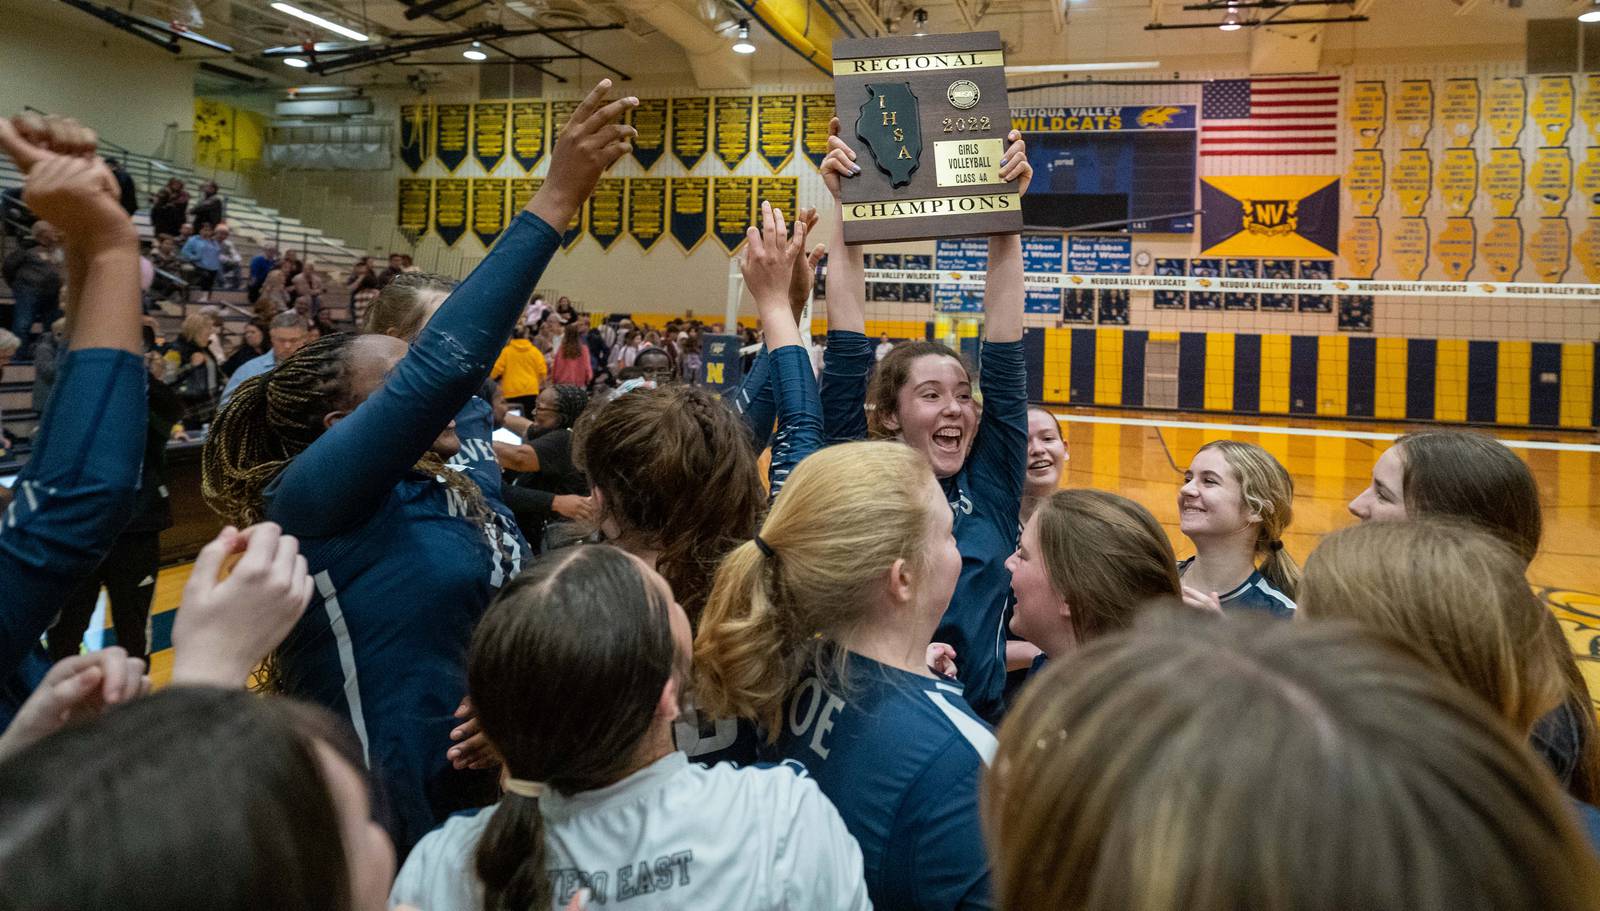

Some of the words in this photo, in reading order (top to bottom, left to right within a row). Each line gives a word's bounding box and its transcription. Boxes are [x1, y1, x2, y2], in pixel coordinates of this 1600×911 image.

[853, 53, 984, 73] REGIONAL
[1010, 108, 1066, 118] NEUQUA
[1070, 107, 1122, 117] VALLEY
[942, 116, 991, 133] 2022
[1011, 116, 1122, 131] WILDCATS
[958, 143, 979, 155] GIRLS
[948, 156, 992, 169] VOLLEYBALL
[955, 173, 976, 184] CLASS
[979, 175, 988, 183] 4A
[852, 195, 1011, 218] CHAMPIONS
[1255, 203, 1286, 226] NV
[881, 271, 905, 280] VALLEY
[905, 271, 940, 280] WILDCATS
[1024, 275, 1060, 284] WILDCATS
[1090, 277, 1119, 286] NEUQUA
[1120, 278, 1147, 286] VALLEY
[1147, 278, 1187, 287] WILDCATS
[1219, 280, 1250, 289] NEUQUA
[1251, 281, 1280, 290] VALLEY
[1281, 282, 1323, 291] WILDCATS
[1357, 283, 1390, 291] NEUQUA
[1392, 283, 1422, 292] VALLEY
[1424, 284, 1468, 293] WILDCATS
[1505, 286, 1540, 294] NEUQUA
[1542, 286, 1574, 295] VALLEY
[706, 362, 725, 384] N
[616, 849, 694, 903] EAST
